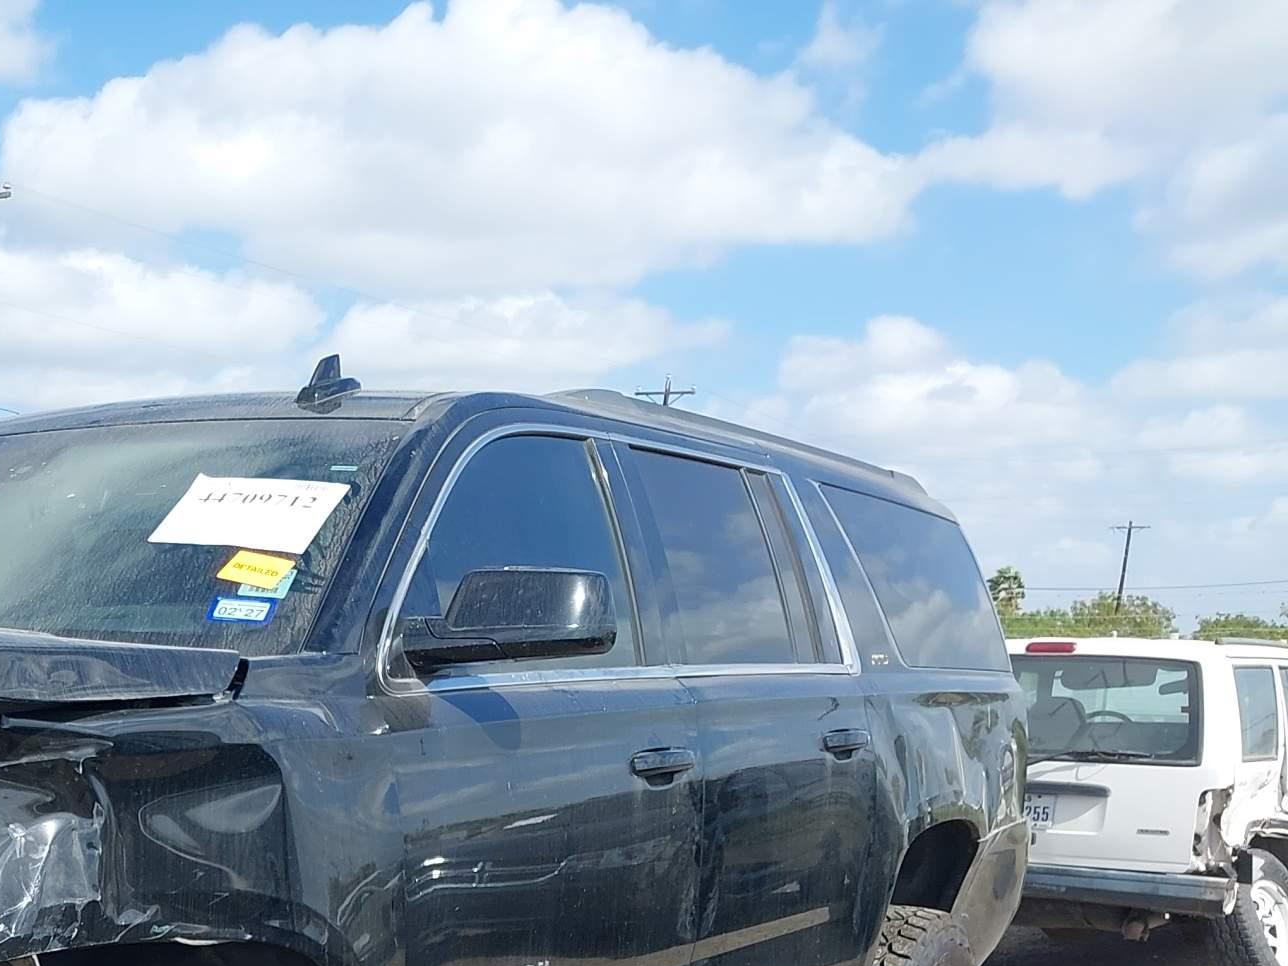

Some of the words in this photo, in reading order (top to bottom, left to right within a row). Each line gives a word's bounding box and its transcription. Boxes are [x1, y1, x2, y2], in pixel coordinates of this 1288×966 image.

[232, 562, 279, 577] DETAILED
[217, 606, 237, 617] 02
[243, 608, 265, 619] 27
[1025, 805, 1050, 822] 255
